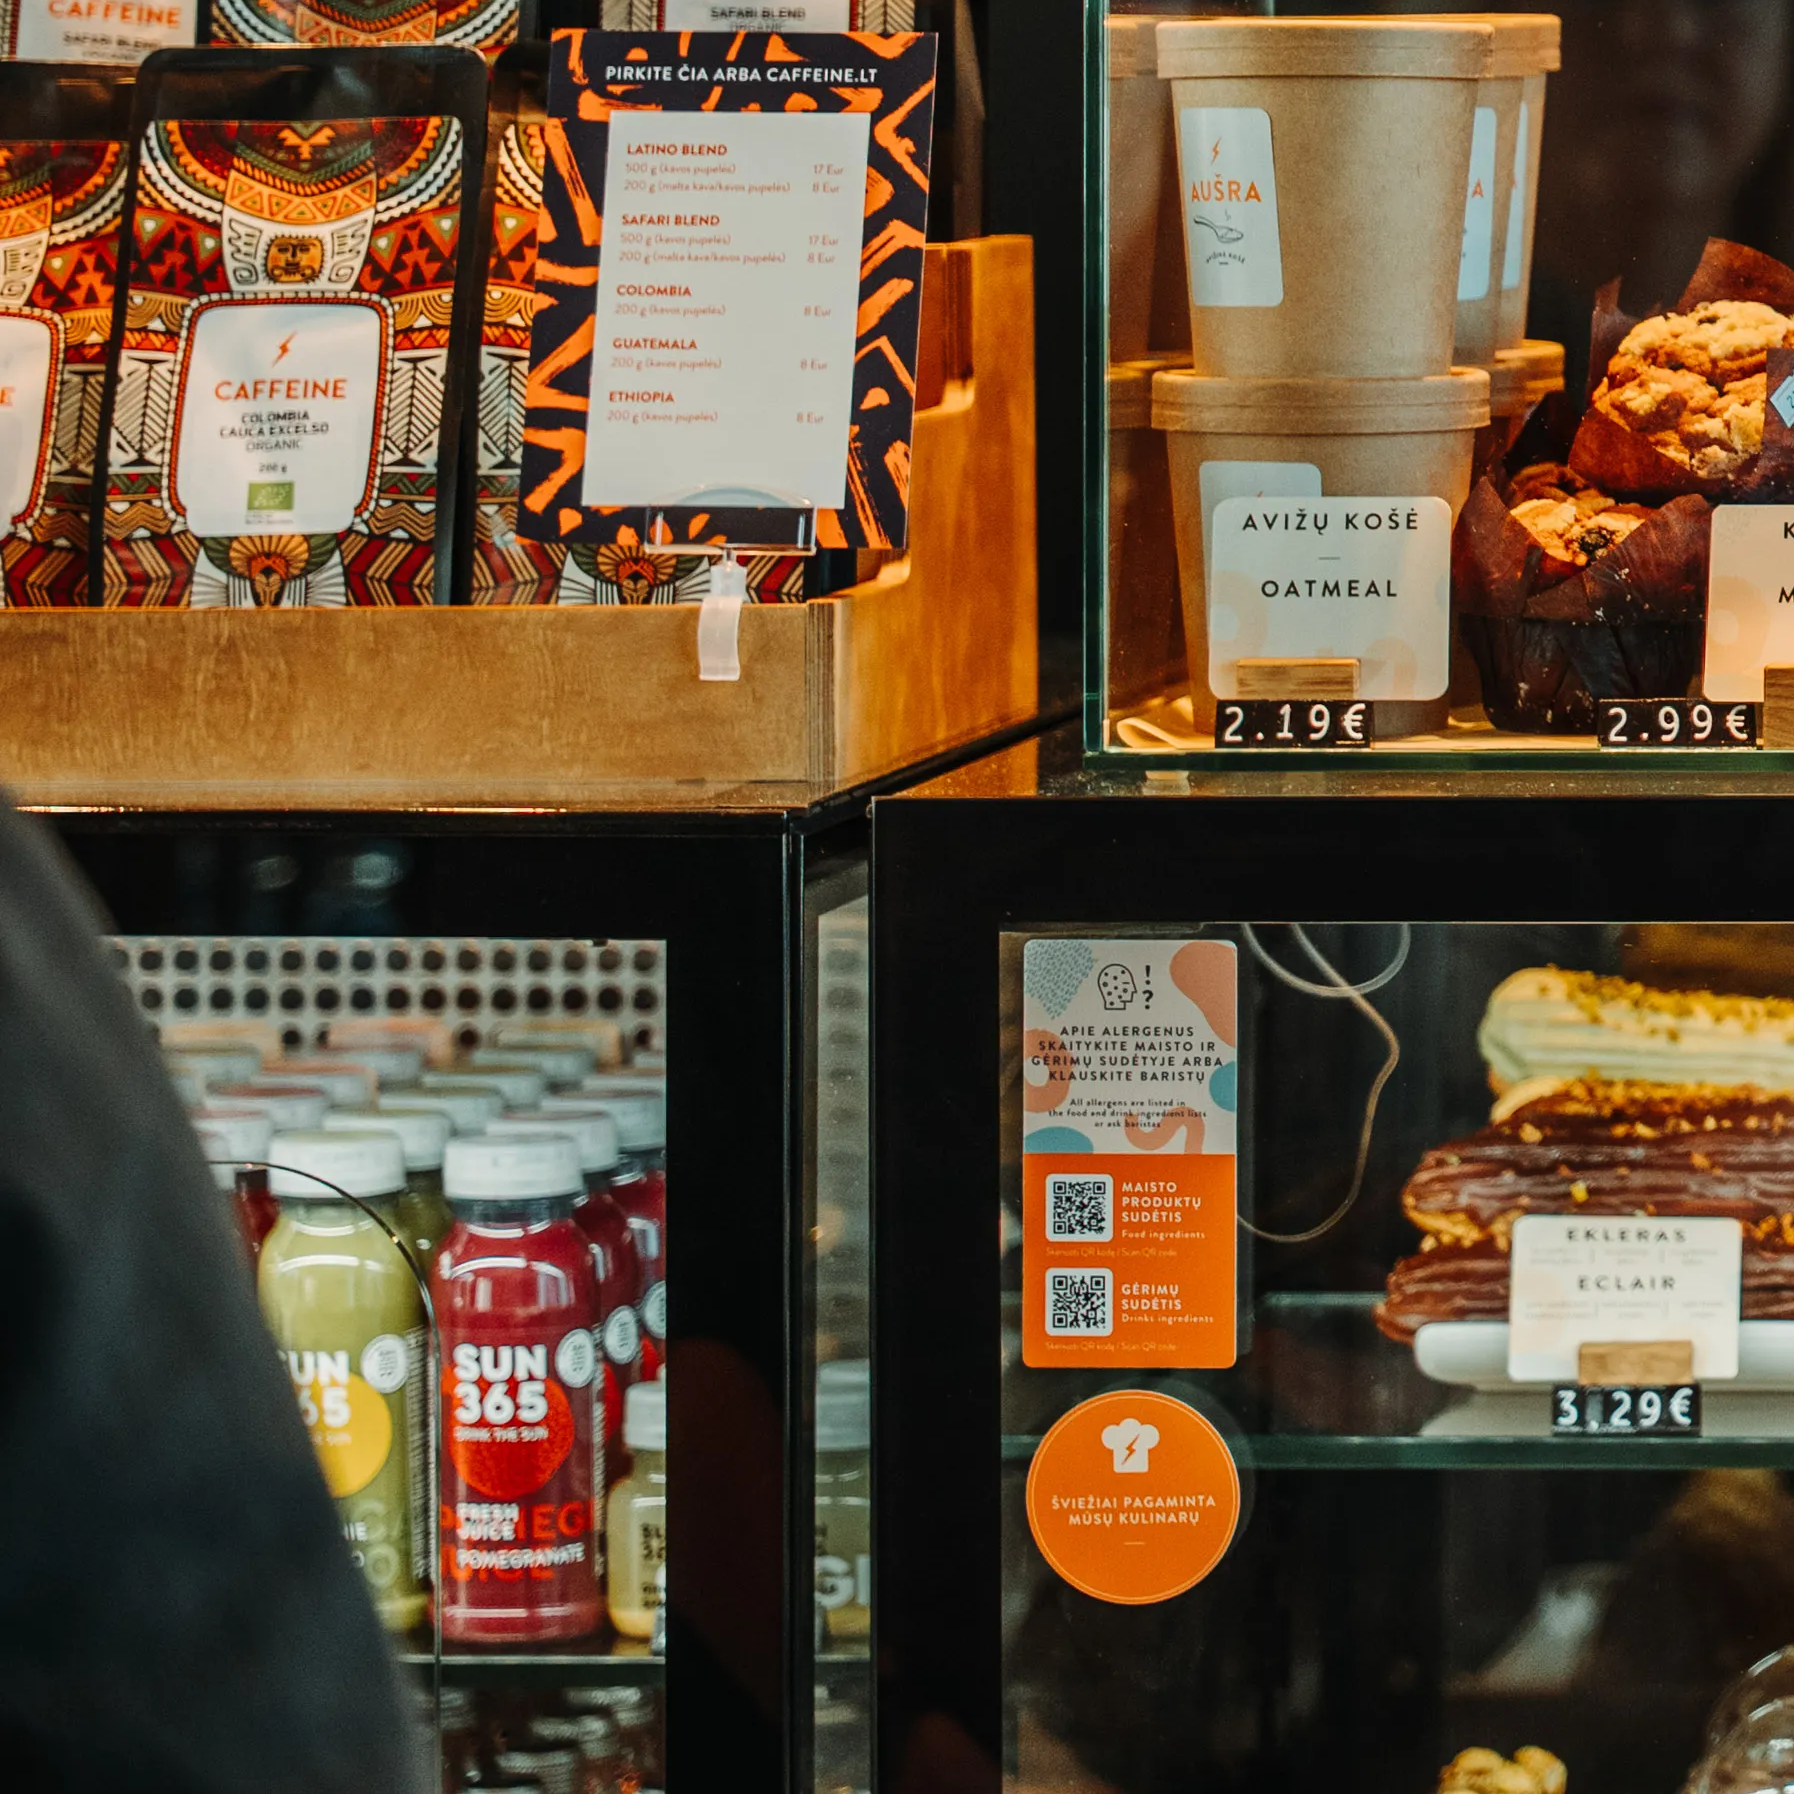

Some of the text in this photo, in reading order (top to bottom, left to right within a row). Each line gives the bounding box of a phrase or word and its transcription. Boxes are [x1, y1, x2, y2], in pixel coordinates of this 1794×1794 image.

[711, 7, 806, 20] SAFARI BLEND
[605, 62, 878, 83] PIRKITE ČIA ARBA CAFFEINE.LT
[627, 143, 727, 156] LATINO BLEND
[1192, 173, 1261, 202] AUŠRA
[622, 214, 720, 227] SAFARI BLEND
[616, 284, 692, 297] COLOMBIA
[613, 337, 697, 350] GUATEMALA
[215, 378, 348, 401] CAFFEINE
[609, 390, 675, 403] ETHIOPIA
[242, 410, 310, 424] COLOMBIA
[1242, 508, 1419, 535] AVIŽŲ KOŠĖ
[1261, 579, 1398, 598] OATMEAL
[1222, 702, 1367, 744] 2.19€
[1607, 704, 1749, 743] 2.99€
[1060, 1026, 1194, 1036] APIE ALERGENUS
[1039, 1041, 1215, 1052] SKAITYKITE MAISTO IR
[1032, 1053, 1224, 1068] GĖRIMŲ SUDĖTYJE ARBA
[1049, 1071, 1205, 1084] KLAUSKITE BARISTŲ
[1070, 1099, 1083, 1107] All
[1087, 1099, 1127, 1109] allergens
[1148, 1099, 1169, 1107] listed
[1067, 1109, 1087, 1118] food
[1110, 1109, 1133, 1118] drink
[1122, 1181, 1177, 1193] MAISTO
[1122, 1196, 1201, 1210] PRODUKTŲ
[1122, 1209, 1182, 1223] SUDĖTIS
[1122, 1229, 1205, 1241] Food ingredients
[1567, 1227, 1688, 1243] EKLERAS
[1122, 1281, 1179, 1298] GĖRIMŲ
[1578, 1275, 1676, 1291] ECLAIR
[1122, 1297, 1182, 1310] SUDĖTIS
[1122, 1313, 1213, 1325] Drinks ingredients
[288, 1350, 351, 1386] UN
[453, 1343, 549, 1383] SUN
[299, 1386, 351, 1428] 65
[454, 1380, 549, 1425] 365
[1556, 1387, 1693, 1431] 3.29€
[1051, 1494, 1216, 1510] ŠVIEŽIAI PAGAMINTA
[456, 1503, 519, 1521] FRESH
[1119, 1511, 1200, 1527] KULINARŲ
[456, 1520, 516, 1541] JUICE
[456, 1542, 586, 1570] POMEGRANATE
